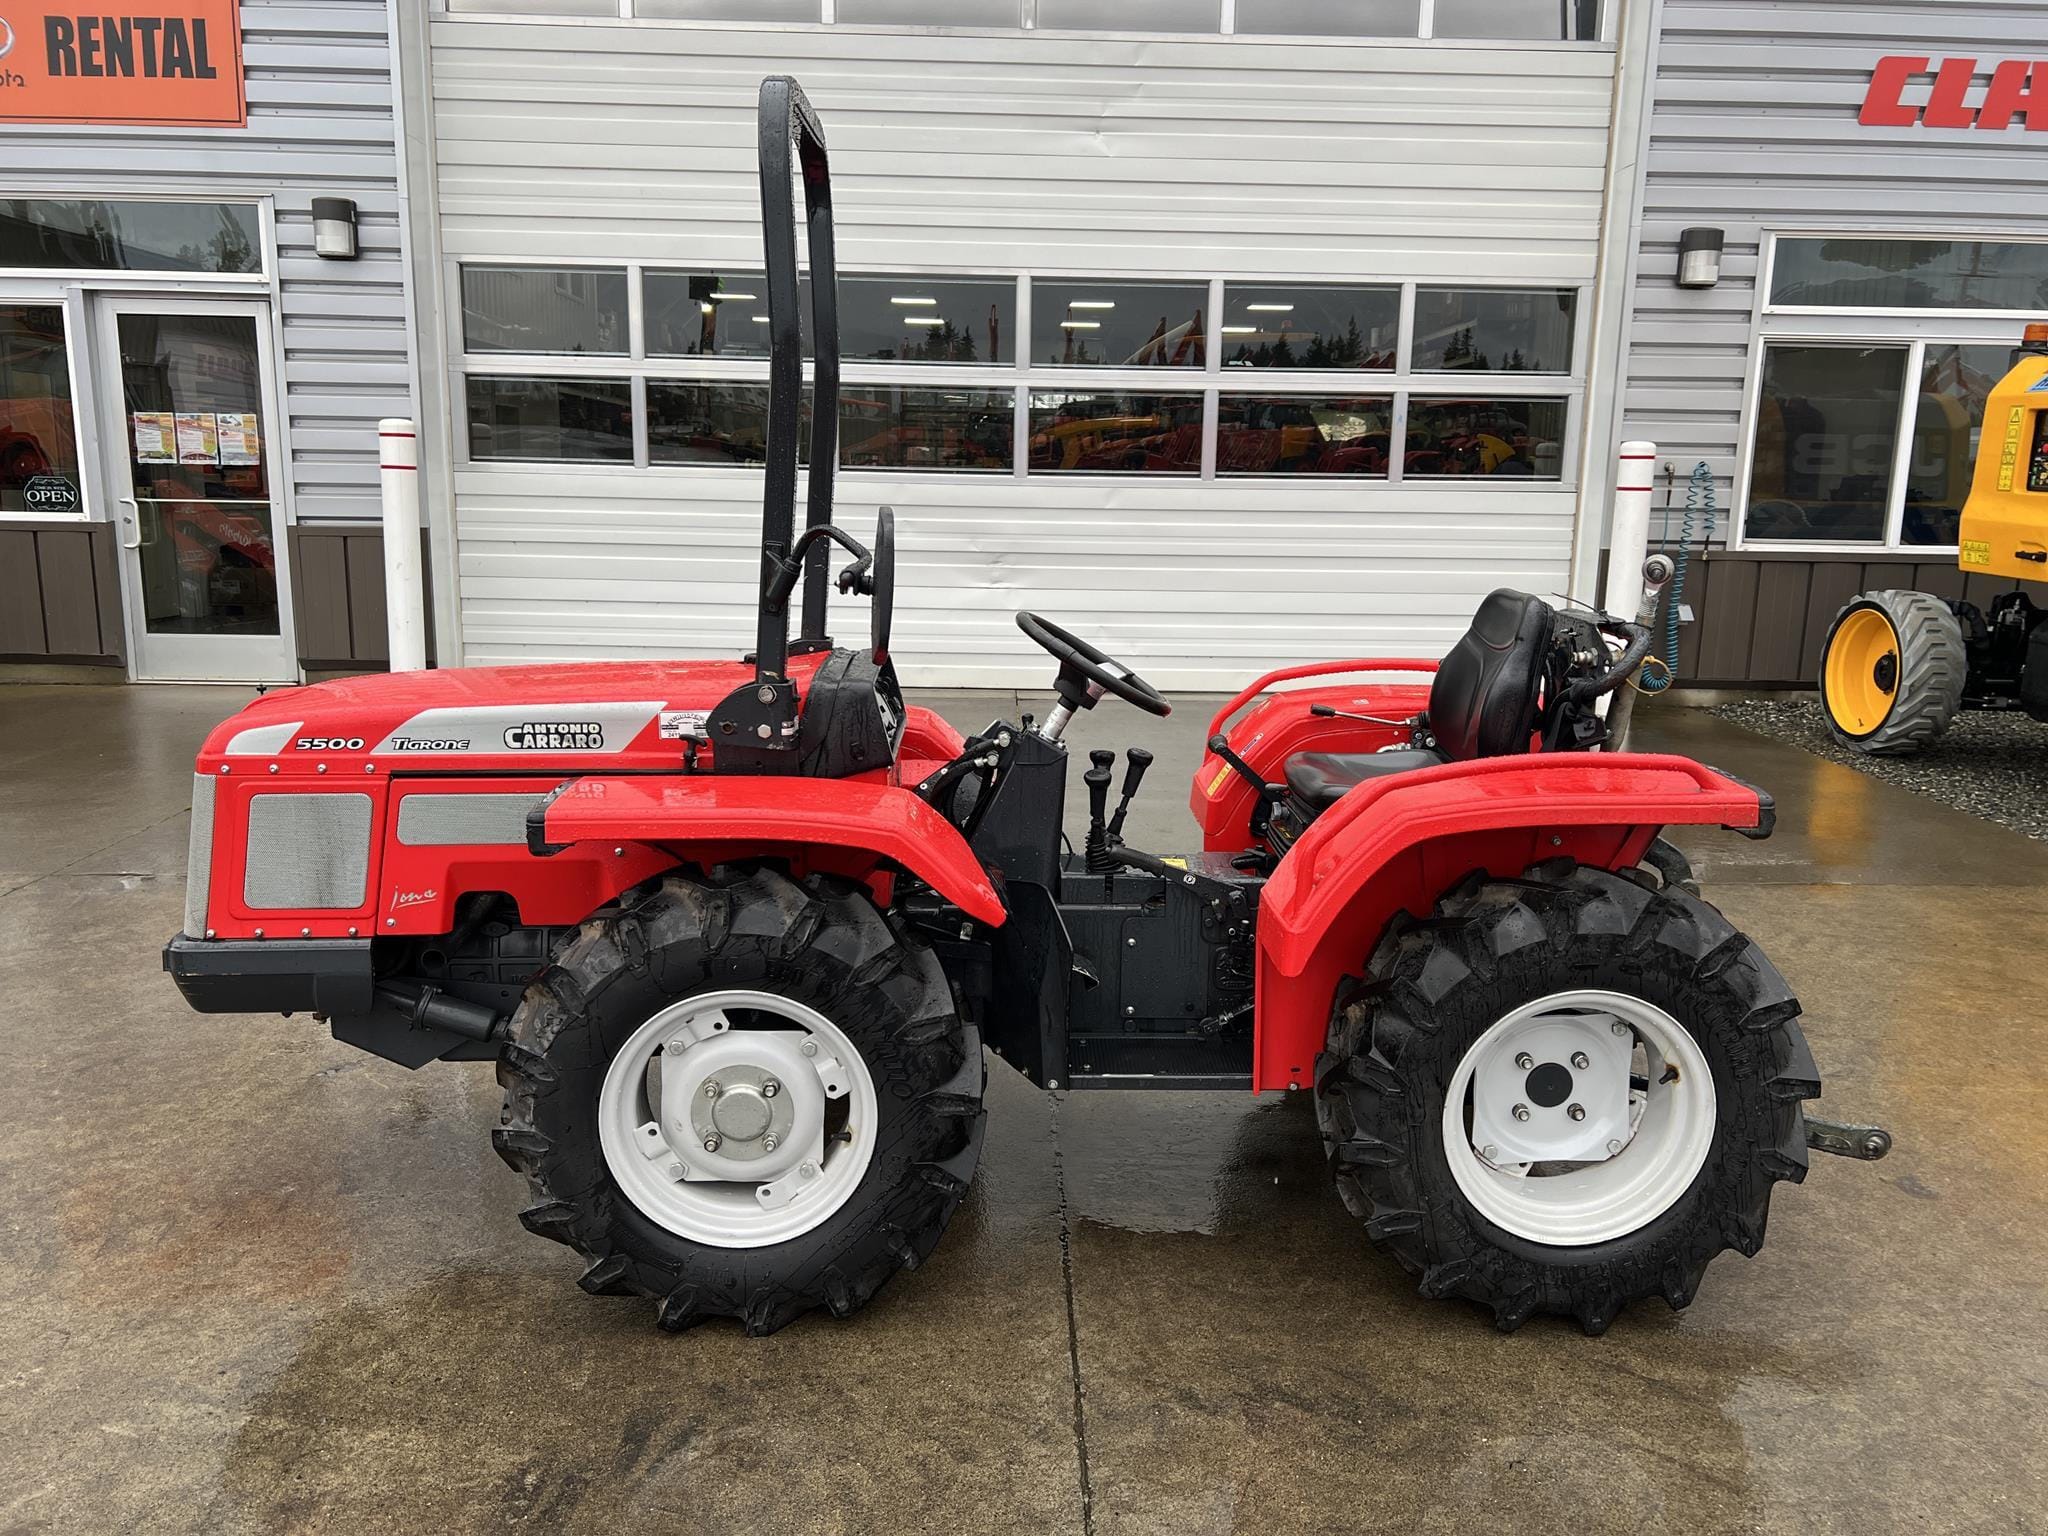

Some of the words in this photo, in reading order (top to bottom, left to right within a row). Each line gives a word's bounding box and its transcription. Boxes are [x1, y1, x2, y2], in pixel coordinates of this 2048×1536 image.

[44, 16, 217, 80] RENTAL
[1857, 55, 2048, 131] CLA
[26, 490, 75, 502] OPEN
[522, 723, 602, 734] ANTONIO
[295, 737, 366, 751] 5500
[504, 728, 603, 749] CARRARO
